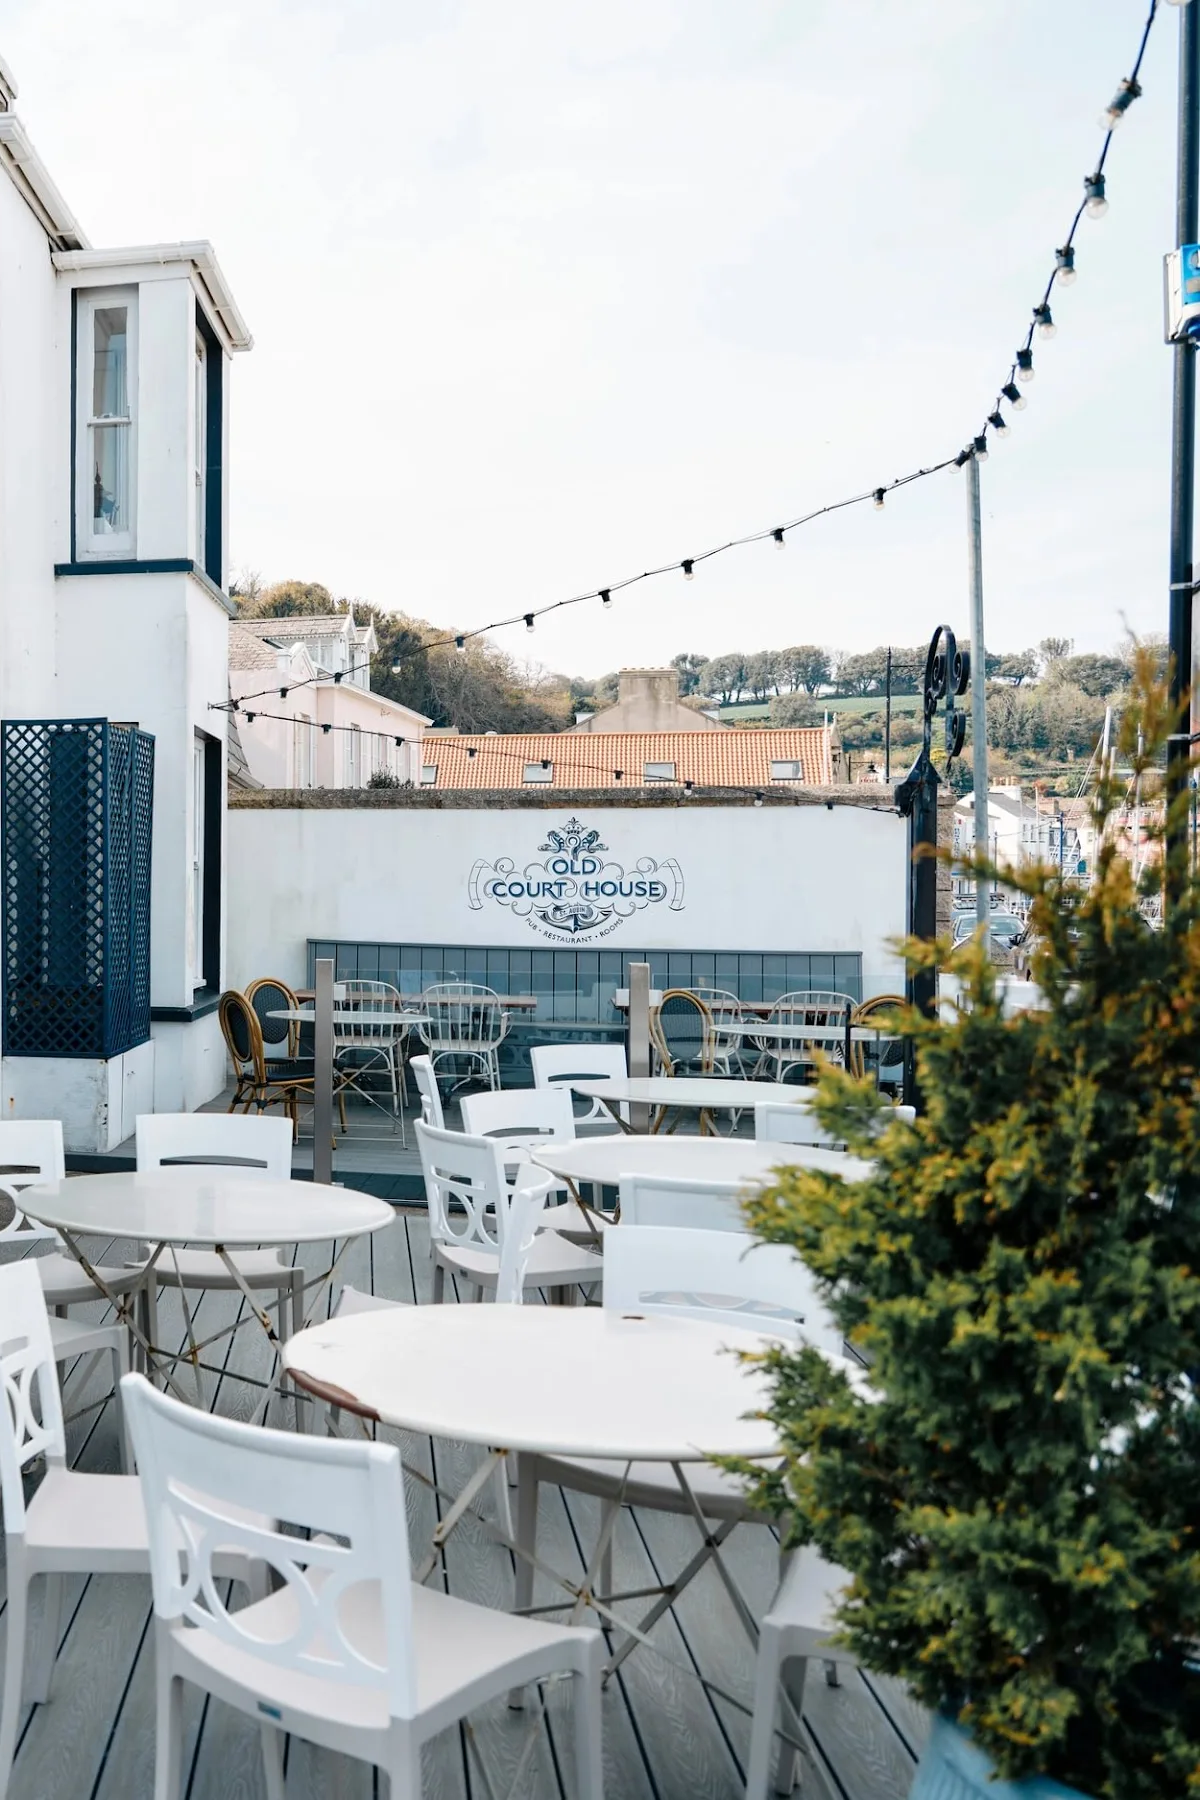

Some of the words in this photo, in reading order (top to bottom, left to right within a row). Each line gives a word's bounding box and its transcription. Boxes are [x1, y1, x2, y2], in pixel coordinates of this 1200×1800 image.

[552, 859, 597, 875] OLD
[492, 881, 567, 898] COURT
[585, 880, 661, 897] HOUSE
[525, 917, 537, 930] PUB
[543, 930, 592, 944] RESTAURANT
[599, 918, 624, 938] ROOMS
